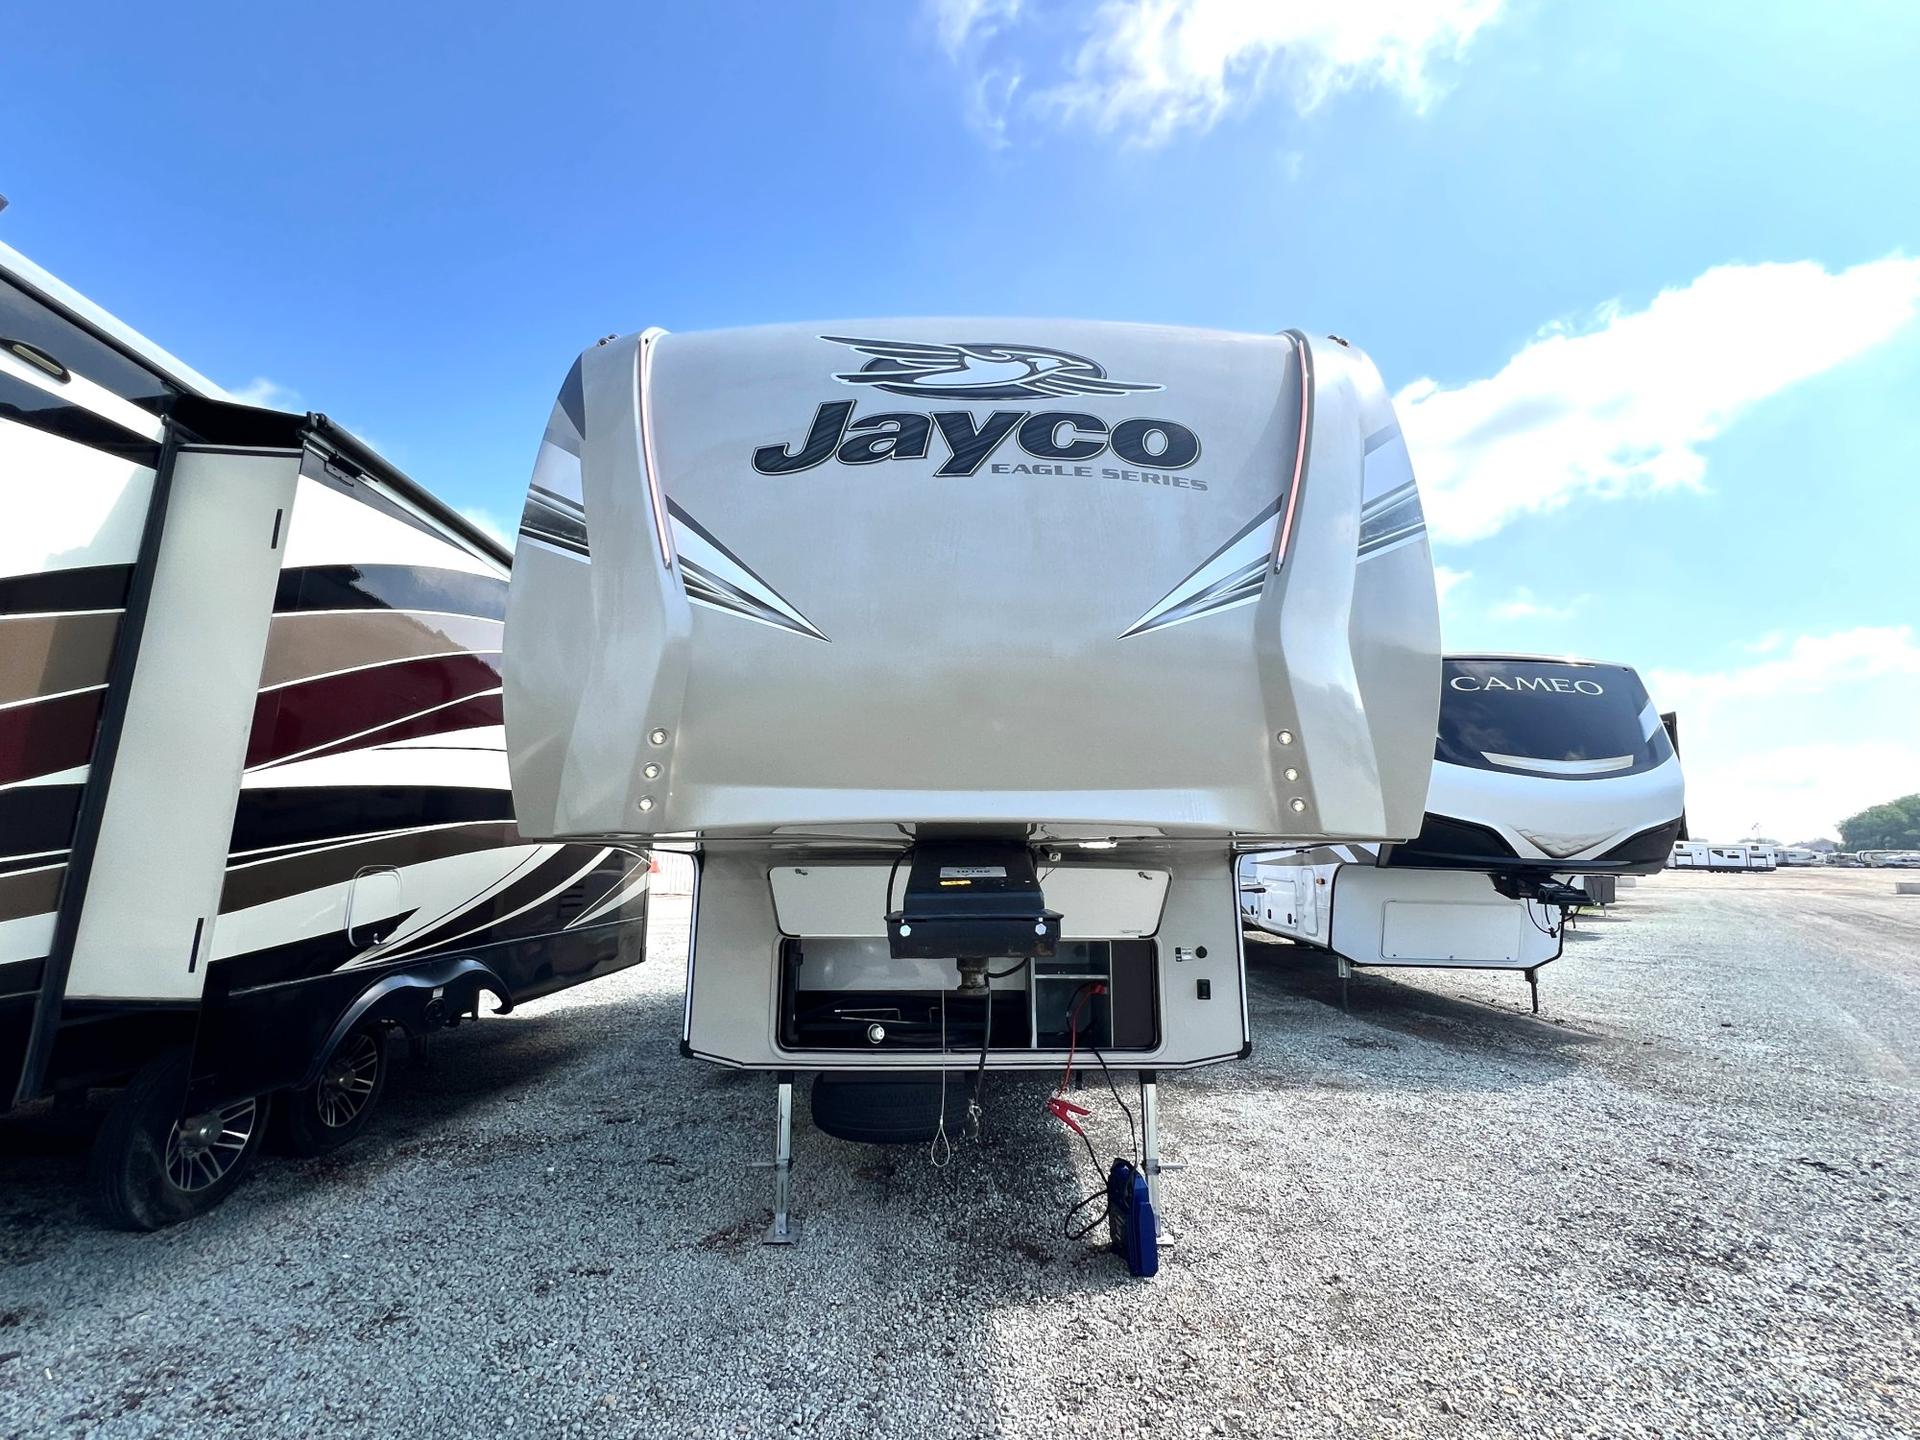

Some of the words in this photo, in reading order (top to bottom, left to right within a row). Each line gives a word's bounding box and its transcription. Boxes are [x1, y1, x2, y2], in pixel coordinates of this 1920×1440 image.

[752, 399, 1202, 477] Jayco
[990, 463, 1093, 478] EAGLE
[1101, 468, 1208, 491] SERIES
[1450, 676, 1604, 695] CAMEO
